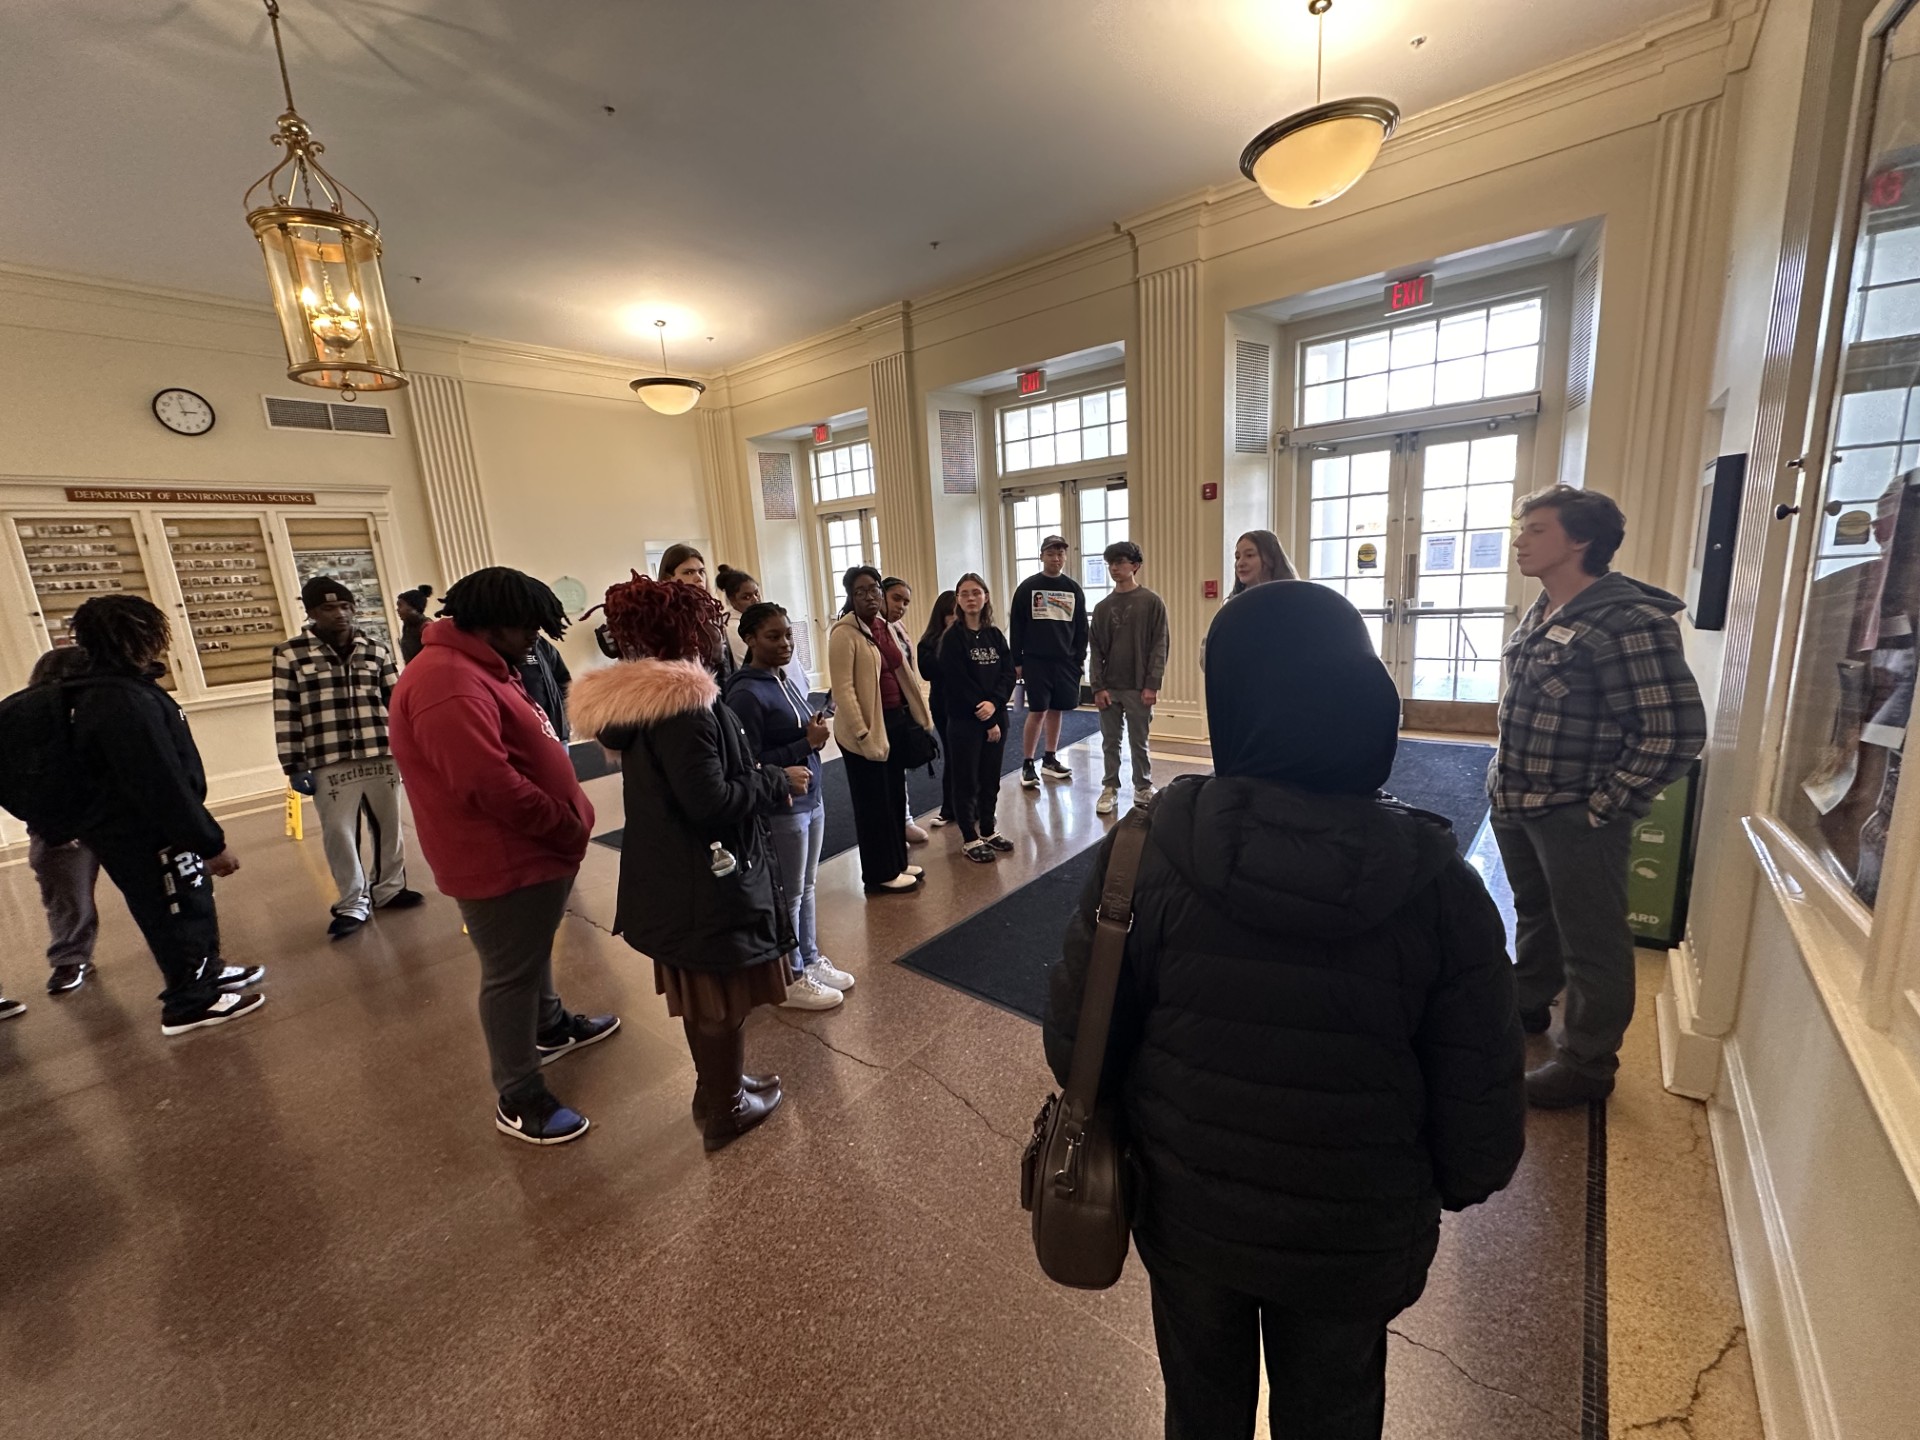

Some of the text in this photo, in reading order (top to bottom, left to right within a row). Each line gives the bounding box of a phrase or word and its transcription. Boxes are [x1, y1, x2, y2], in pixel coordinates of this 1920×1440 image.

[1392, 277, 1424, 309] EXIT
[1022, 371, 1040, 393] EXIT
[74, 490, 312, 502] DEPARTMENT OF ENVIRONMENTAL SCIENCES
